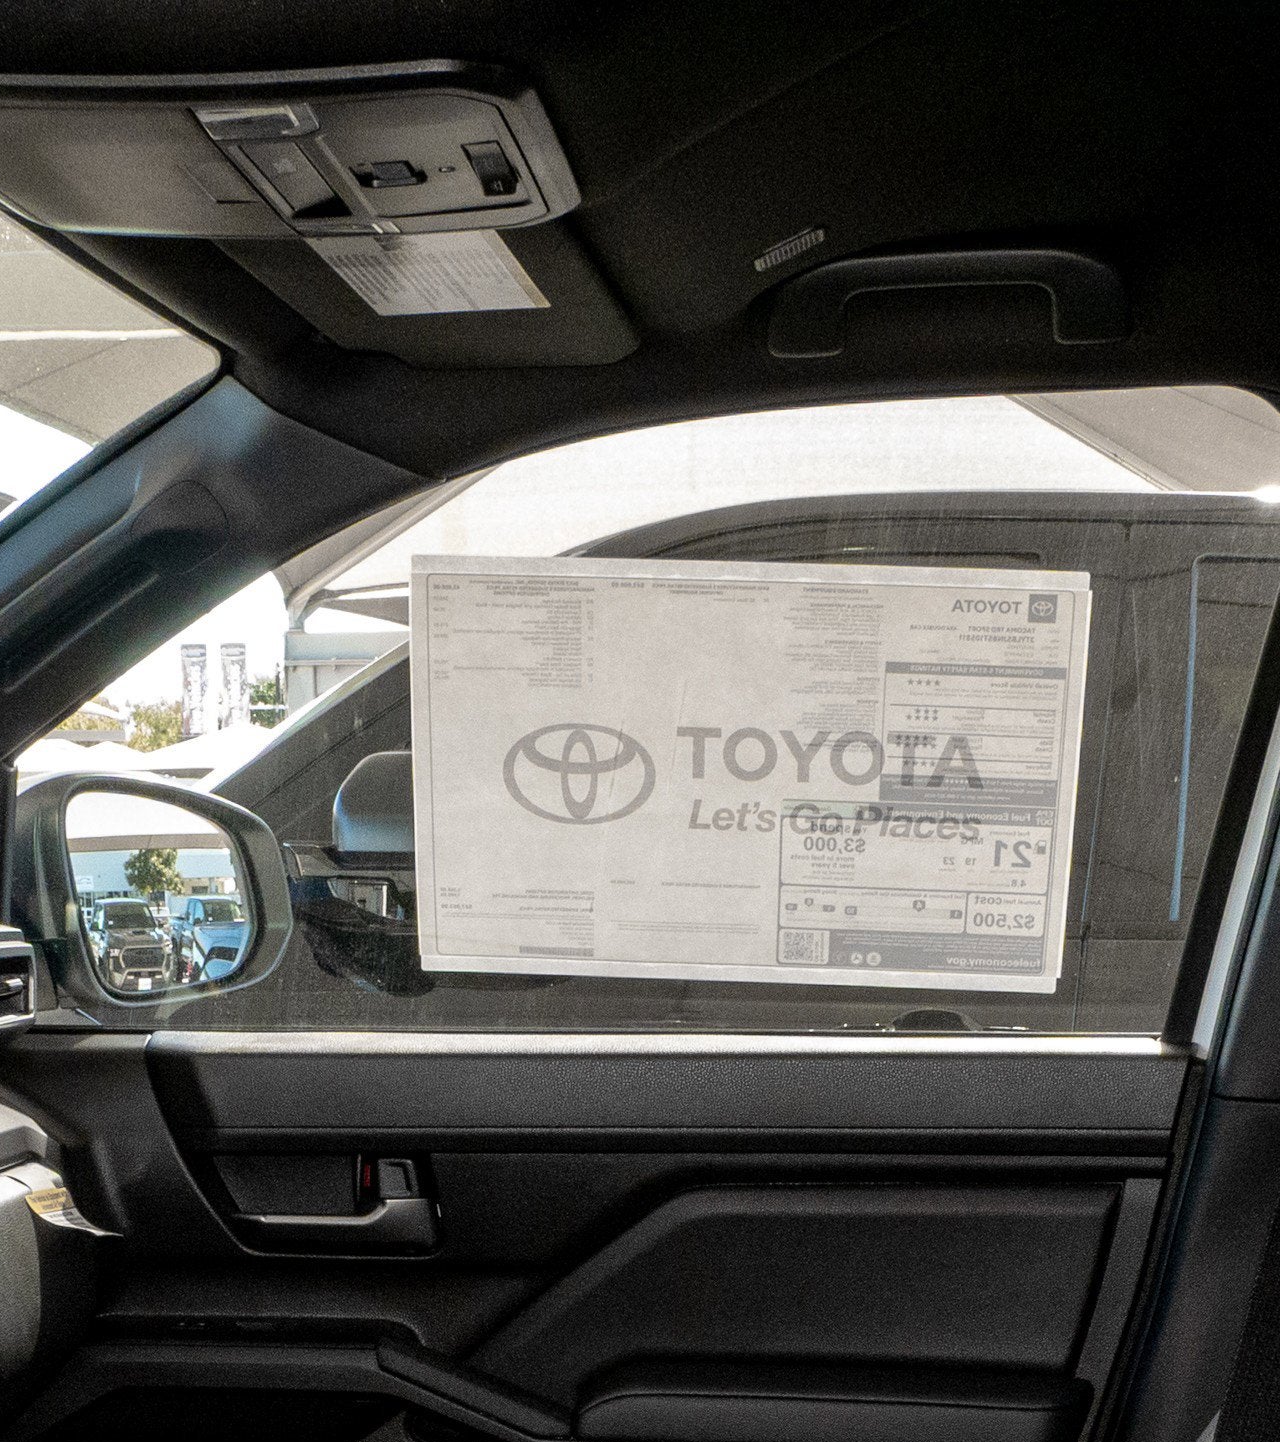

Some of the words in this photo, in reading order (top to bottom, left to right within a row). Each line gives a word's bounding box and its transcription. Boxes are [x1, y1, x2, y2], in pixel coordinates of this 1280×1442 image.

[676, 726, 984, 790] TOYOTA
[688, 799, 777, 832] Let's
[790, 802, 843, 835] Go
[852, 805, 982, 841] Places
